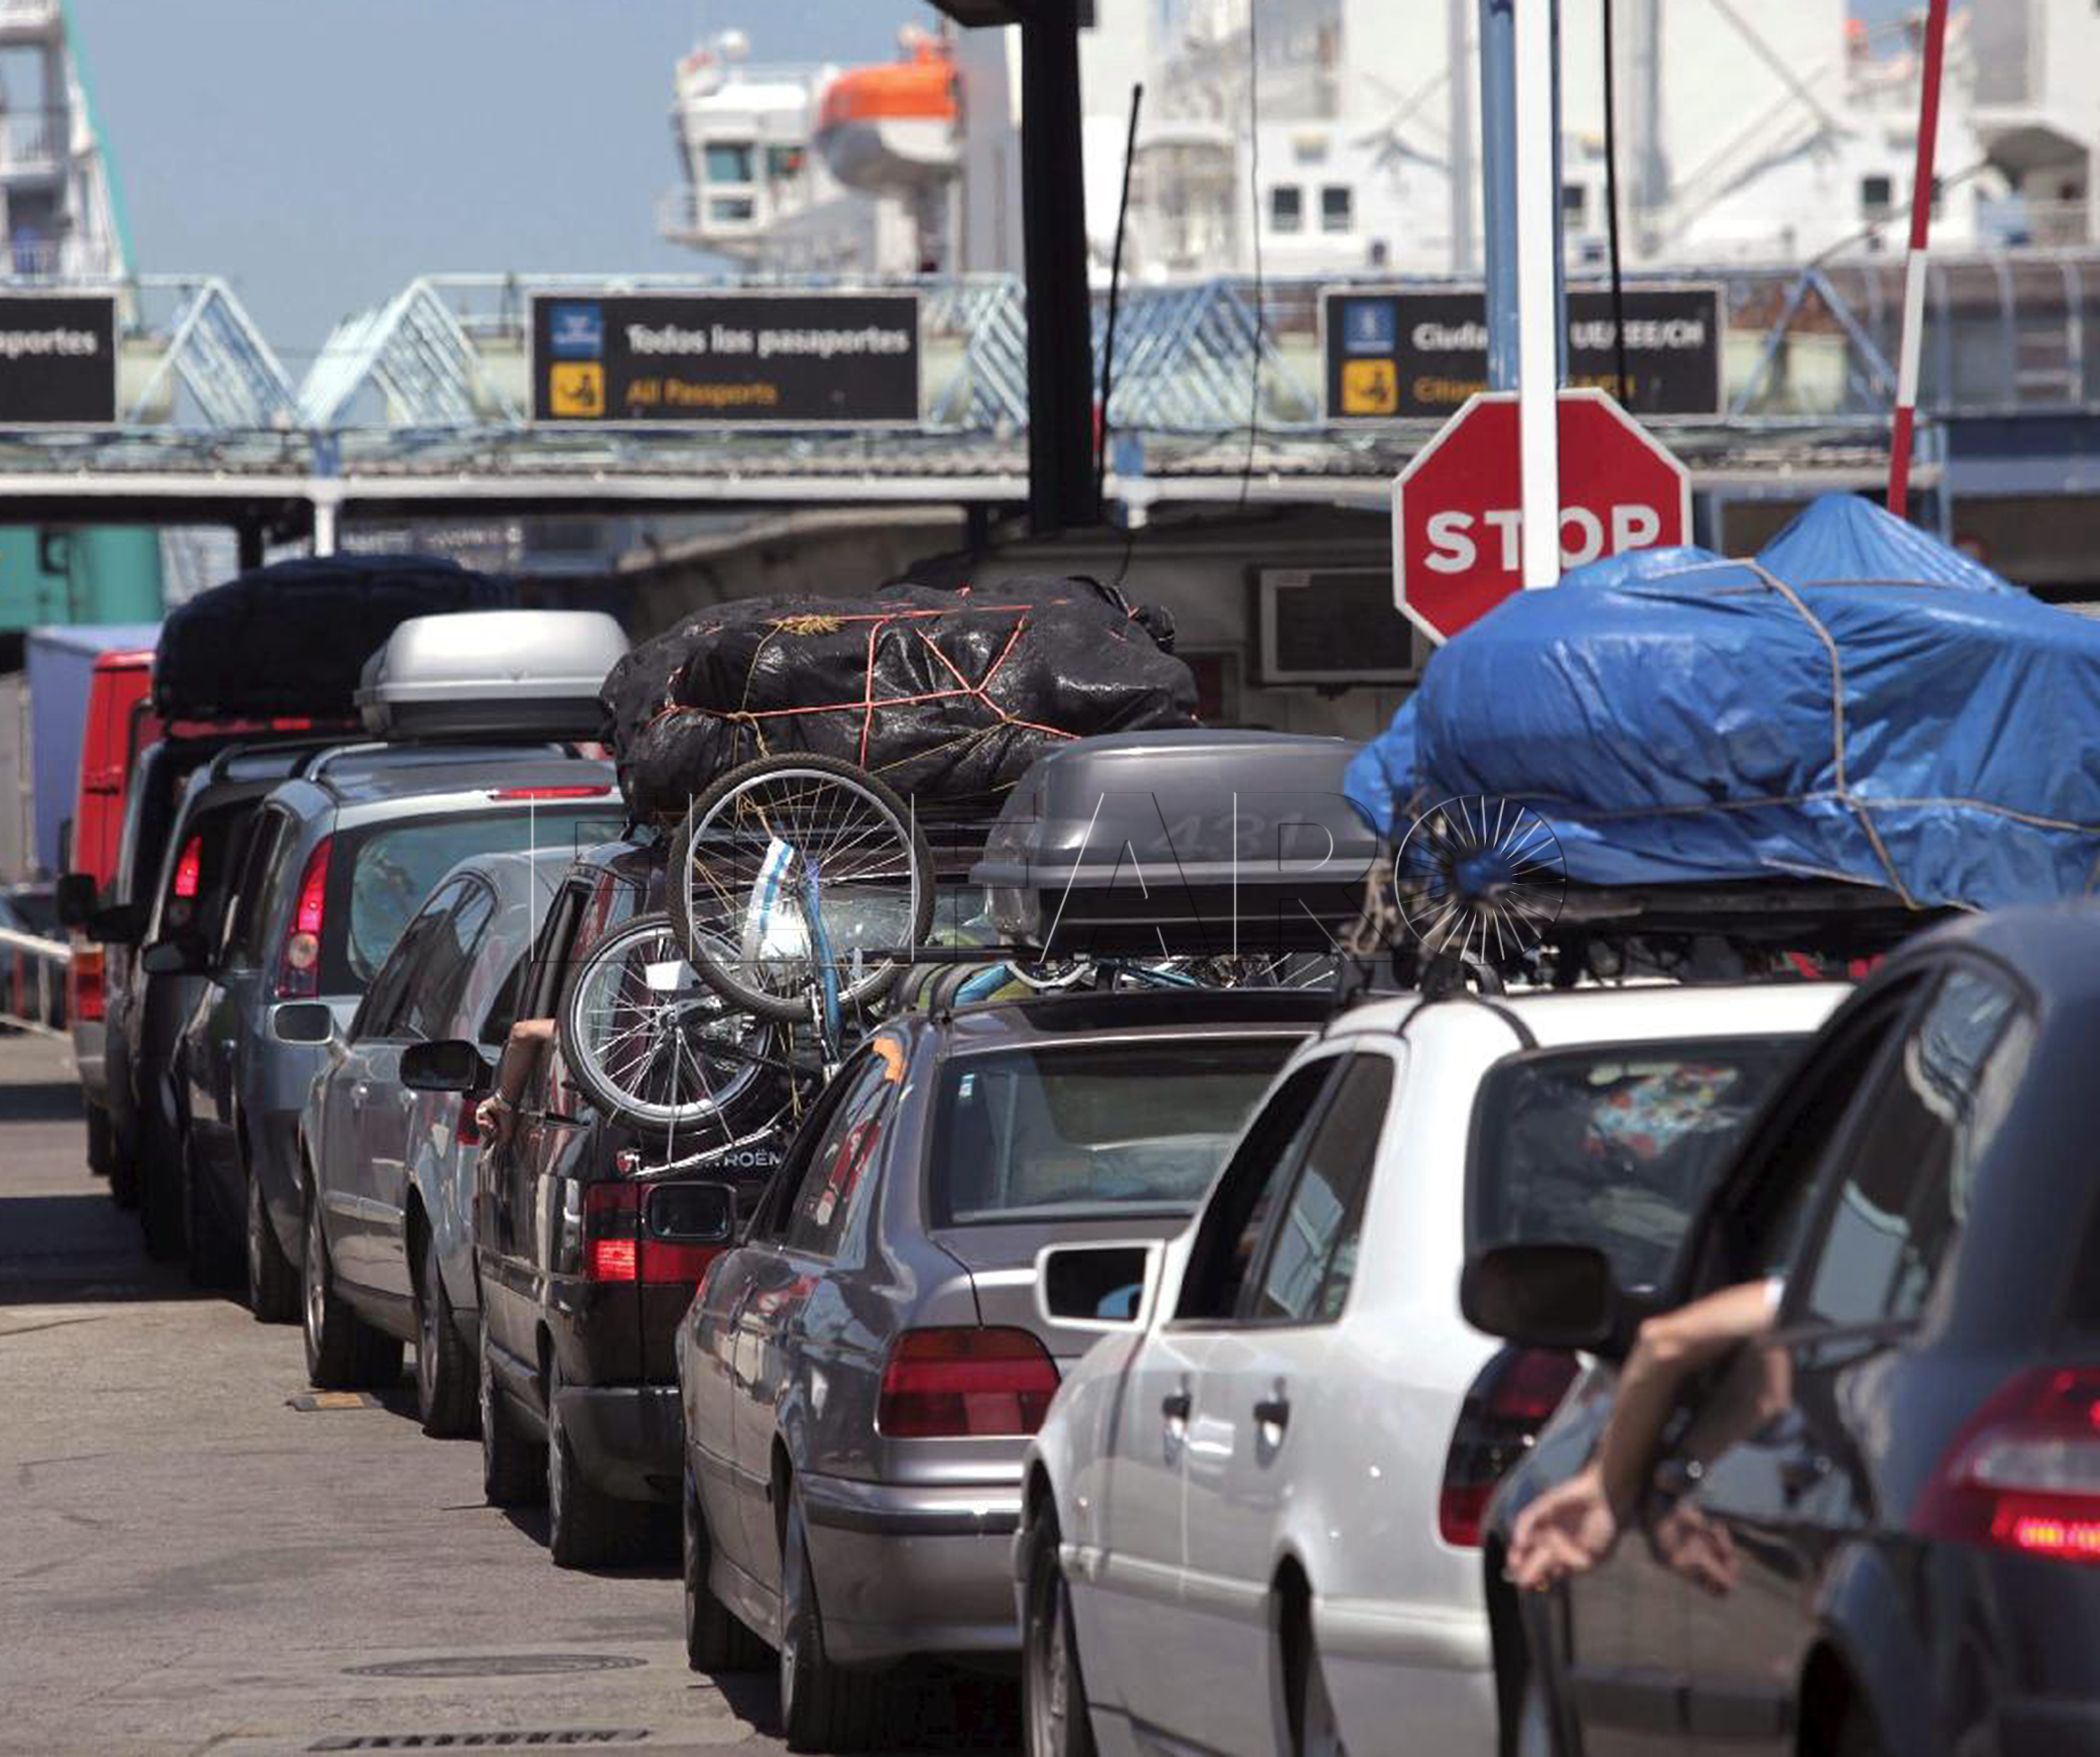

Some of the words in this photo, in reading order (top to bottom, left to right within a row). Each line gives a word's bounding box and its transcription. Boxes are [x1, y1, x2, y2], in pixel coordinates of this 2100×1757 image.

[626, 323, 707, 354] Todos
[711, 323, 754, 354] los
[626, 378, 661, 405] All
[664, 378, 778, 407] Passports
[1423, 503, 1660, 574] STOP
